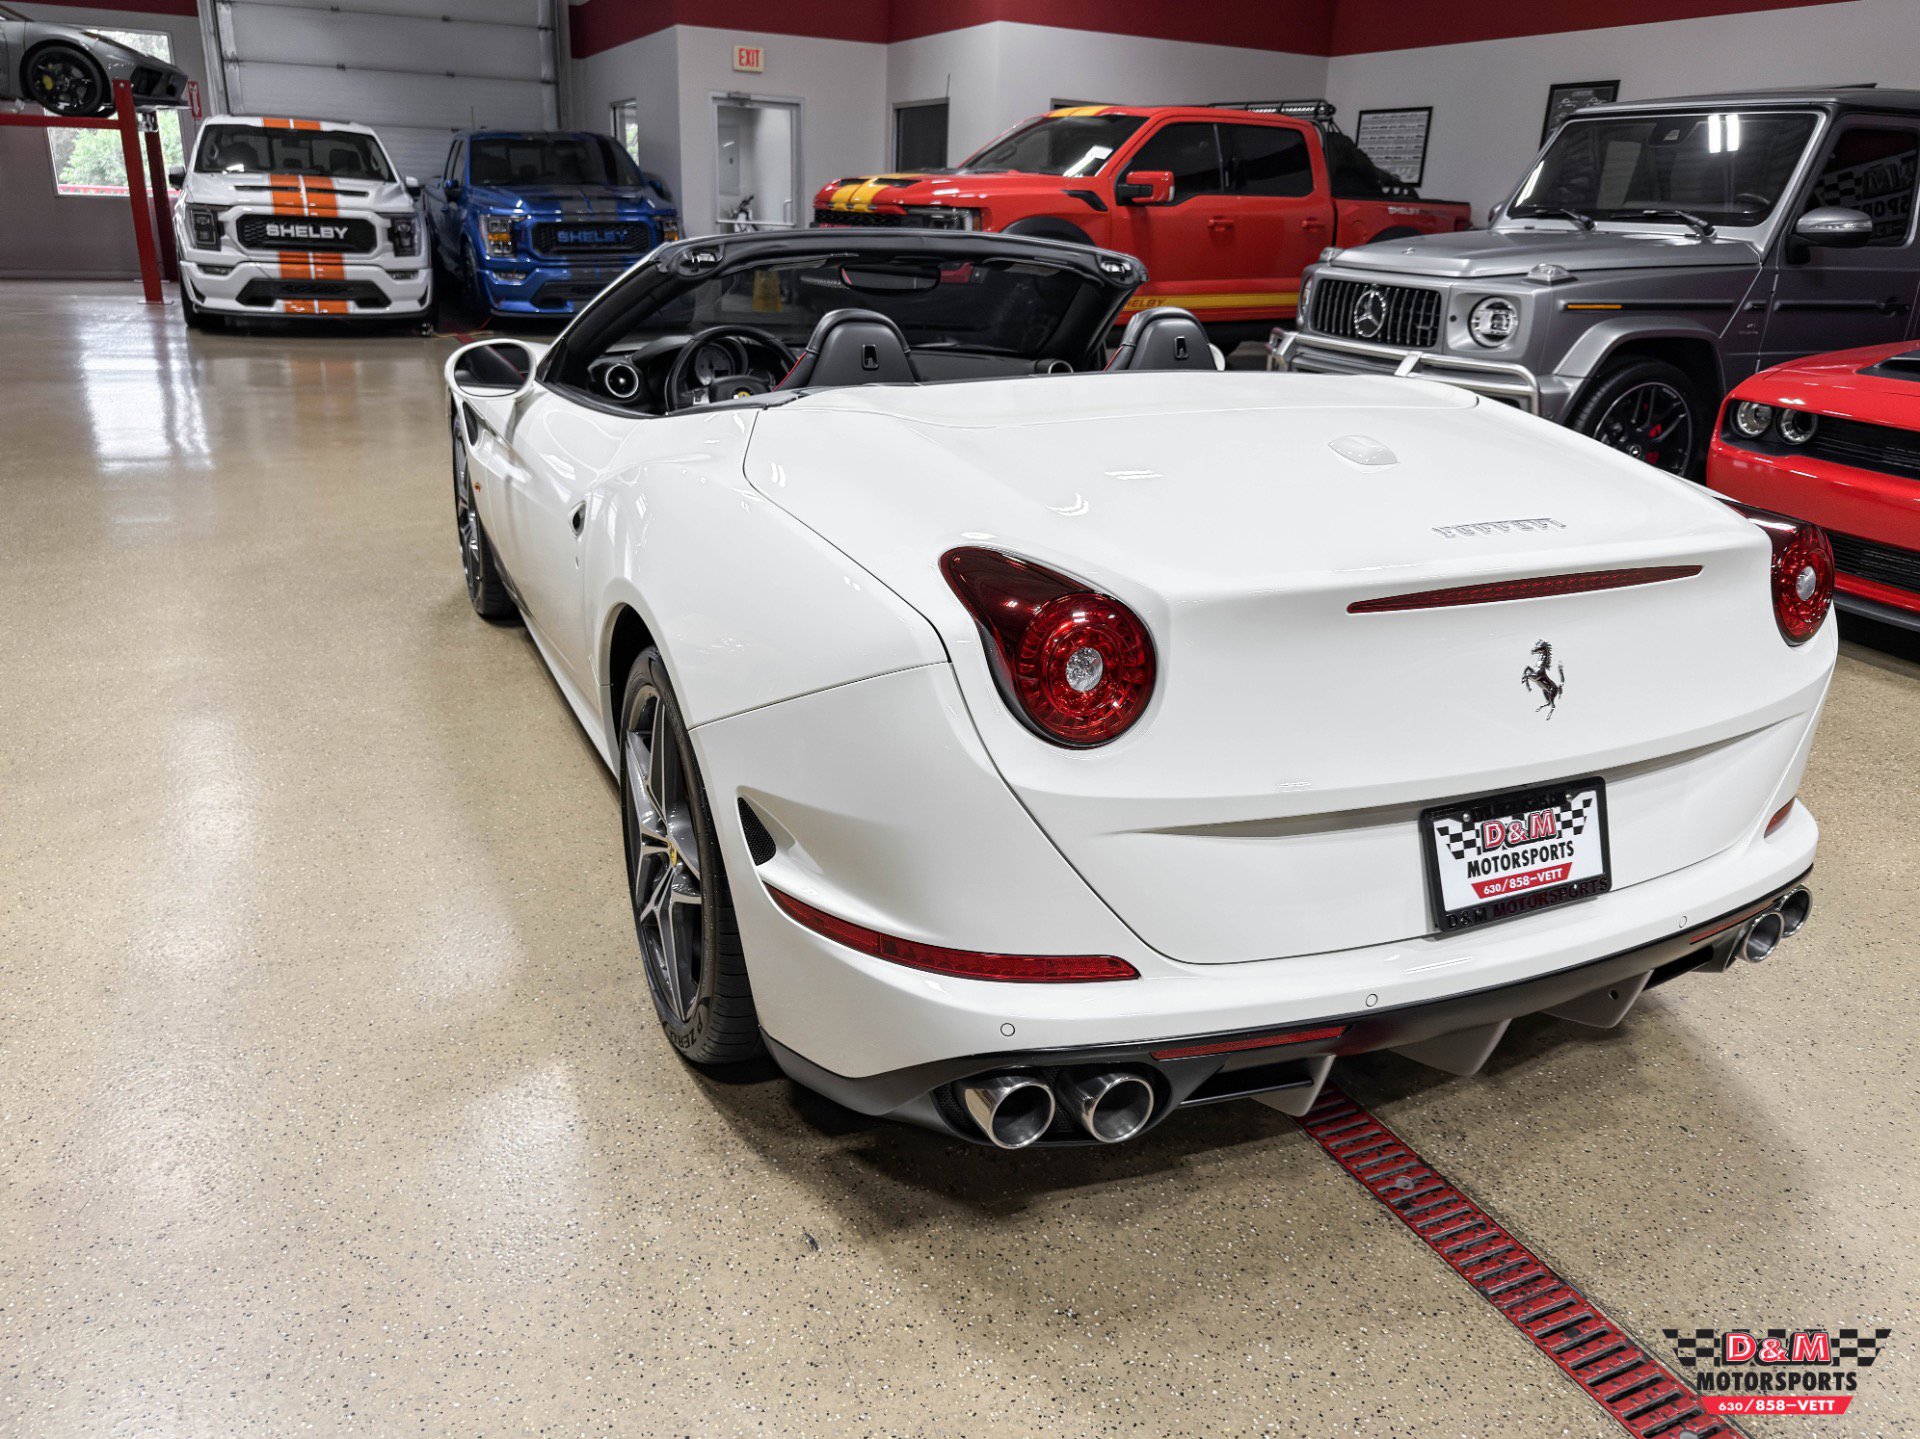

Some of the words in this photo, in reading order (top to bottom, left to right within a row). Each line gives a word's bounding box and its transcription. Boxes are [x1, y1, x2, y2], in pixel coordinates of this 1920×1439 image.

[739, 48, 760, 67] EXIT
[266, 224, 348, 239] SHELBY
[557, 230, 628, 242] SHELBY
[1481, 809, 1557, 850] D&M
[1467, 841, 1574, 878] MOTORSPORTS
[1483, 868, 1563, 894] 630/858-VETT
[1447, 906, 1487, 928] D&M
[1493, 877, 1608, 917] MOTORSPORTS
